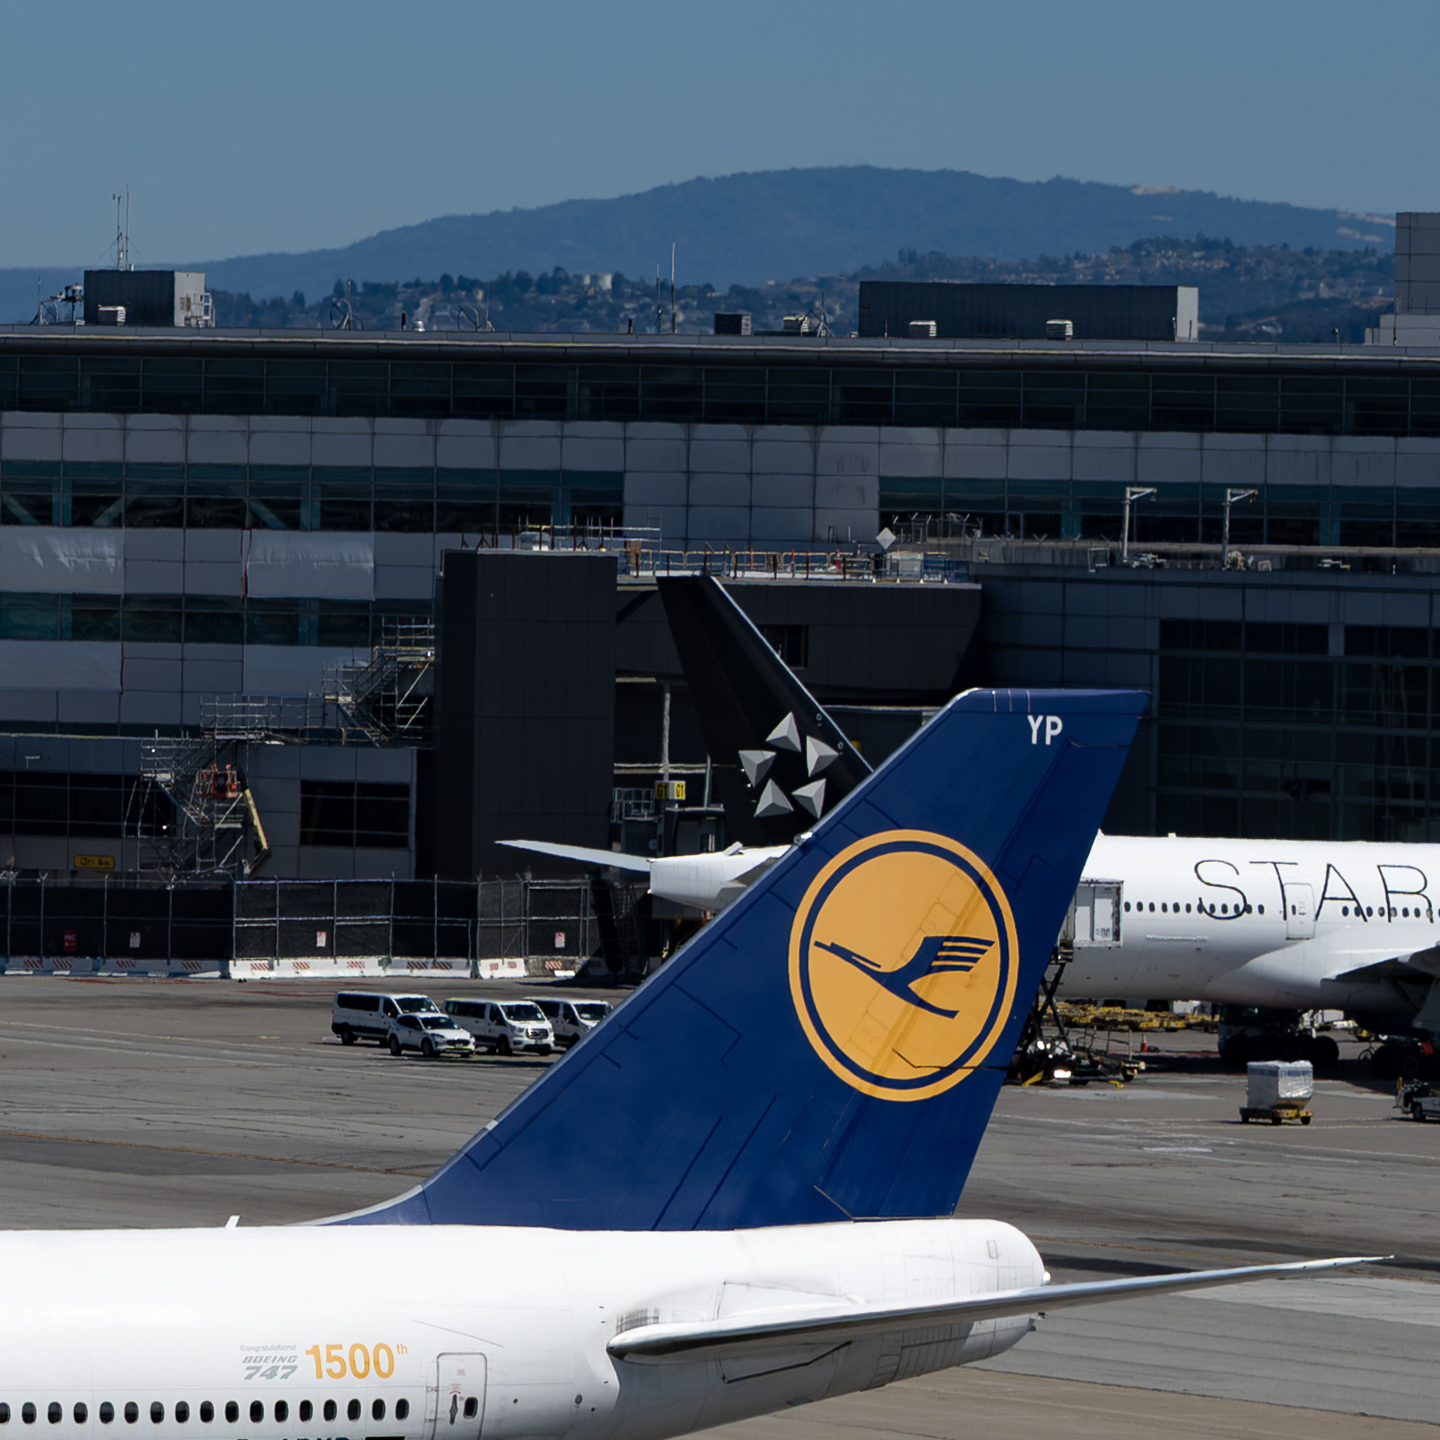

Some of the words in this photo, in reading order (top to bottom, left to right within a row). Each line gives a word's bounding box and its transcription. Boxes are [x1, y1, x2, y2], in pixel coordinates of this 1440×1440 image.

[1027, 714, 1063, 746] YP
[1193, 859, 1435, 924] STAR
[241, 1355, 298, 1364] BOEING
[243, 1365, 299, 1381] 747
